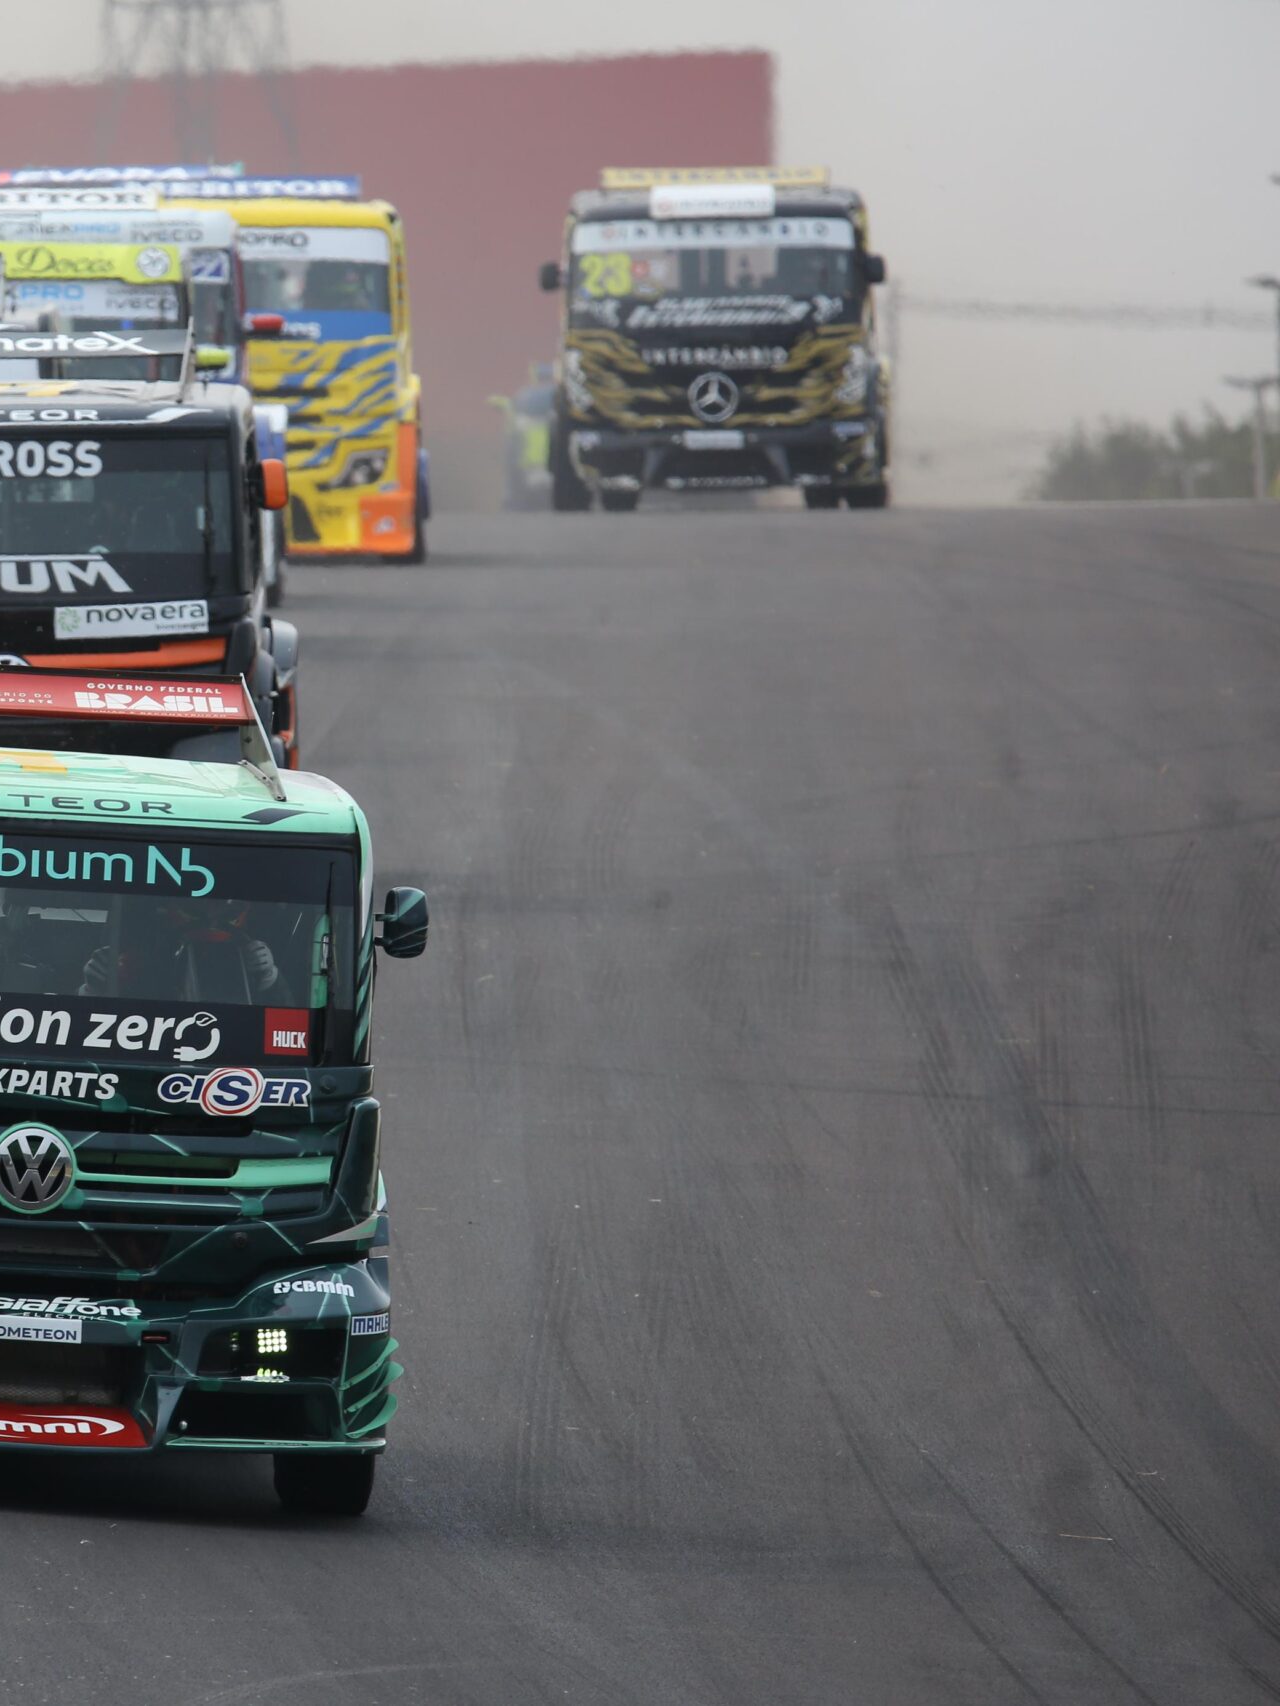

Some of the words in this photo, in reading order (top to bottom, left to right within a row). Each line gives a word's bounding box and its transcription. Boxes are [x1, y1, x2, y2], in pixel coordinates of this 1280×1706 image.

[579, 252, 632, 296] 23
[86, 682, 154, 692] GOVERNO
[160, 686, 222, 695] FEDERAL
[74, 691, 239, 713] BRASIL
[83, 1011, 220, 1061] zero
[272, 1030, 306, 1049] HUCK
[158, 1069, 311, 1112] CISER
[352, 1314, 389, 1334] MAHLE
